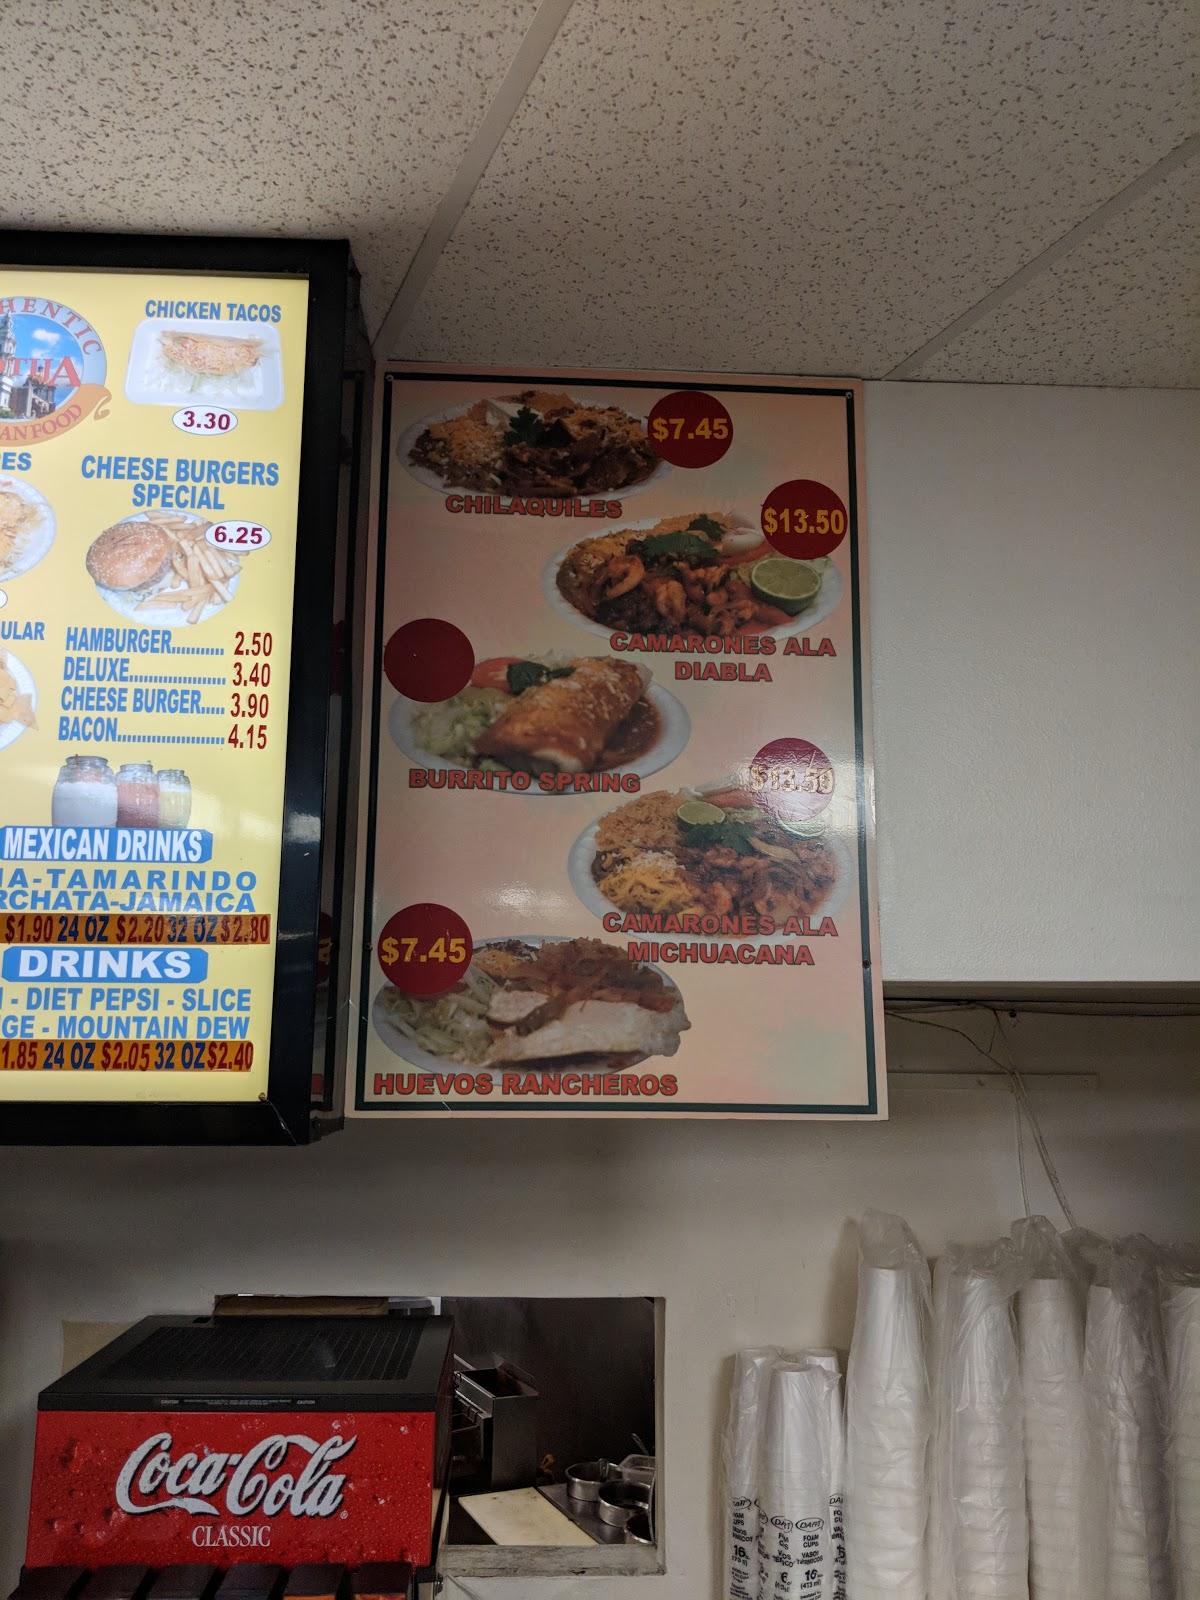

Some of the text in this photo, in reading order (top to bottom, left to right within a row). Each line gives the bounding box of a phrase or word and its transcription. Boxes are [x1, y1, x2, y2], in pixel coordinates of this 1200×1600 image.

[145, 300, 281, 323] CHICKEN TACOS
[31, 404, 82, 438] FOOD
[183, 410, 231, 430] 3.30
[652, 418, 729, 441] $7.45
[0, 452, 32, 471] ES
[81, 455, 279, 486] CHEESE BURGERS
[132, 483, 225, 510] SPECIAL
[445, 495, 622, 518] CHILAQUILES
[763, 508, 845, 535] $13.50
[214, 526, 263, 544] 6.25
[1, 621, 45, 640] ULAR
[234, 631, 273, 656] 2.50
[609, 632, 837, 657] CAMARONES ALA
[232, 661, 271, 687] 3.40
[674, 660, 773, 682] DIABLA
[61, 686, 127, 712] CHEESE
[230, 693, 269, 718] 3.90
[228, 724, 267, 749] 4.15
[408, 768, 641, 793] BURRITO SPRING
[4, 828, 202, 862] MEXICAN DRINKS
[5, 915, 53, 944] $1.90
[57, 915, 79, 942] 24
[84, 915, 109, 942] OZ
[116, 915, 164, 944] $2.20
[167, 916, 187, 943] 32
[193, 916, 217, 943] OZ
[602, 912, 838, 937] CAMARONES ALA
[381, 936, 467, 964] $7.45
[627, 941, 815, 966] MICHUACANA
[19, 950, 191, 979] DRINKS
[26, 987, 83, 1011] DIET
[90, 988, 159, 1011] PEPSI
[182, 988, 251, 1012] SLICE
[2, 1015, 35, 1038] GE
[57, 1015, 188, 1039] MOUNTAIN
[196, 1016, 250, 1039] DEW
[2, 1040, 254, 1071] 1.85 24 OZ $2.05 32 OZ $2.40
[373, 1072, 678, 1096] HUEVOS RANCHEROS
[115, 1432, 357, 1517] Coca-Cola
[191, 1525, 271, 1548] CLASSIC
